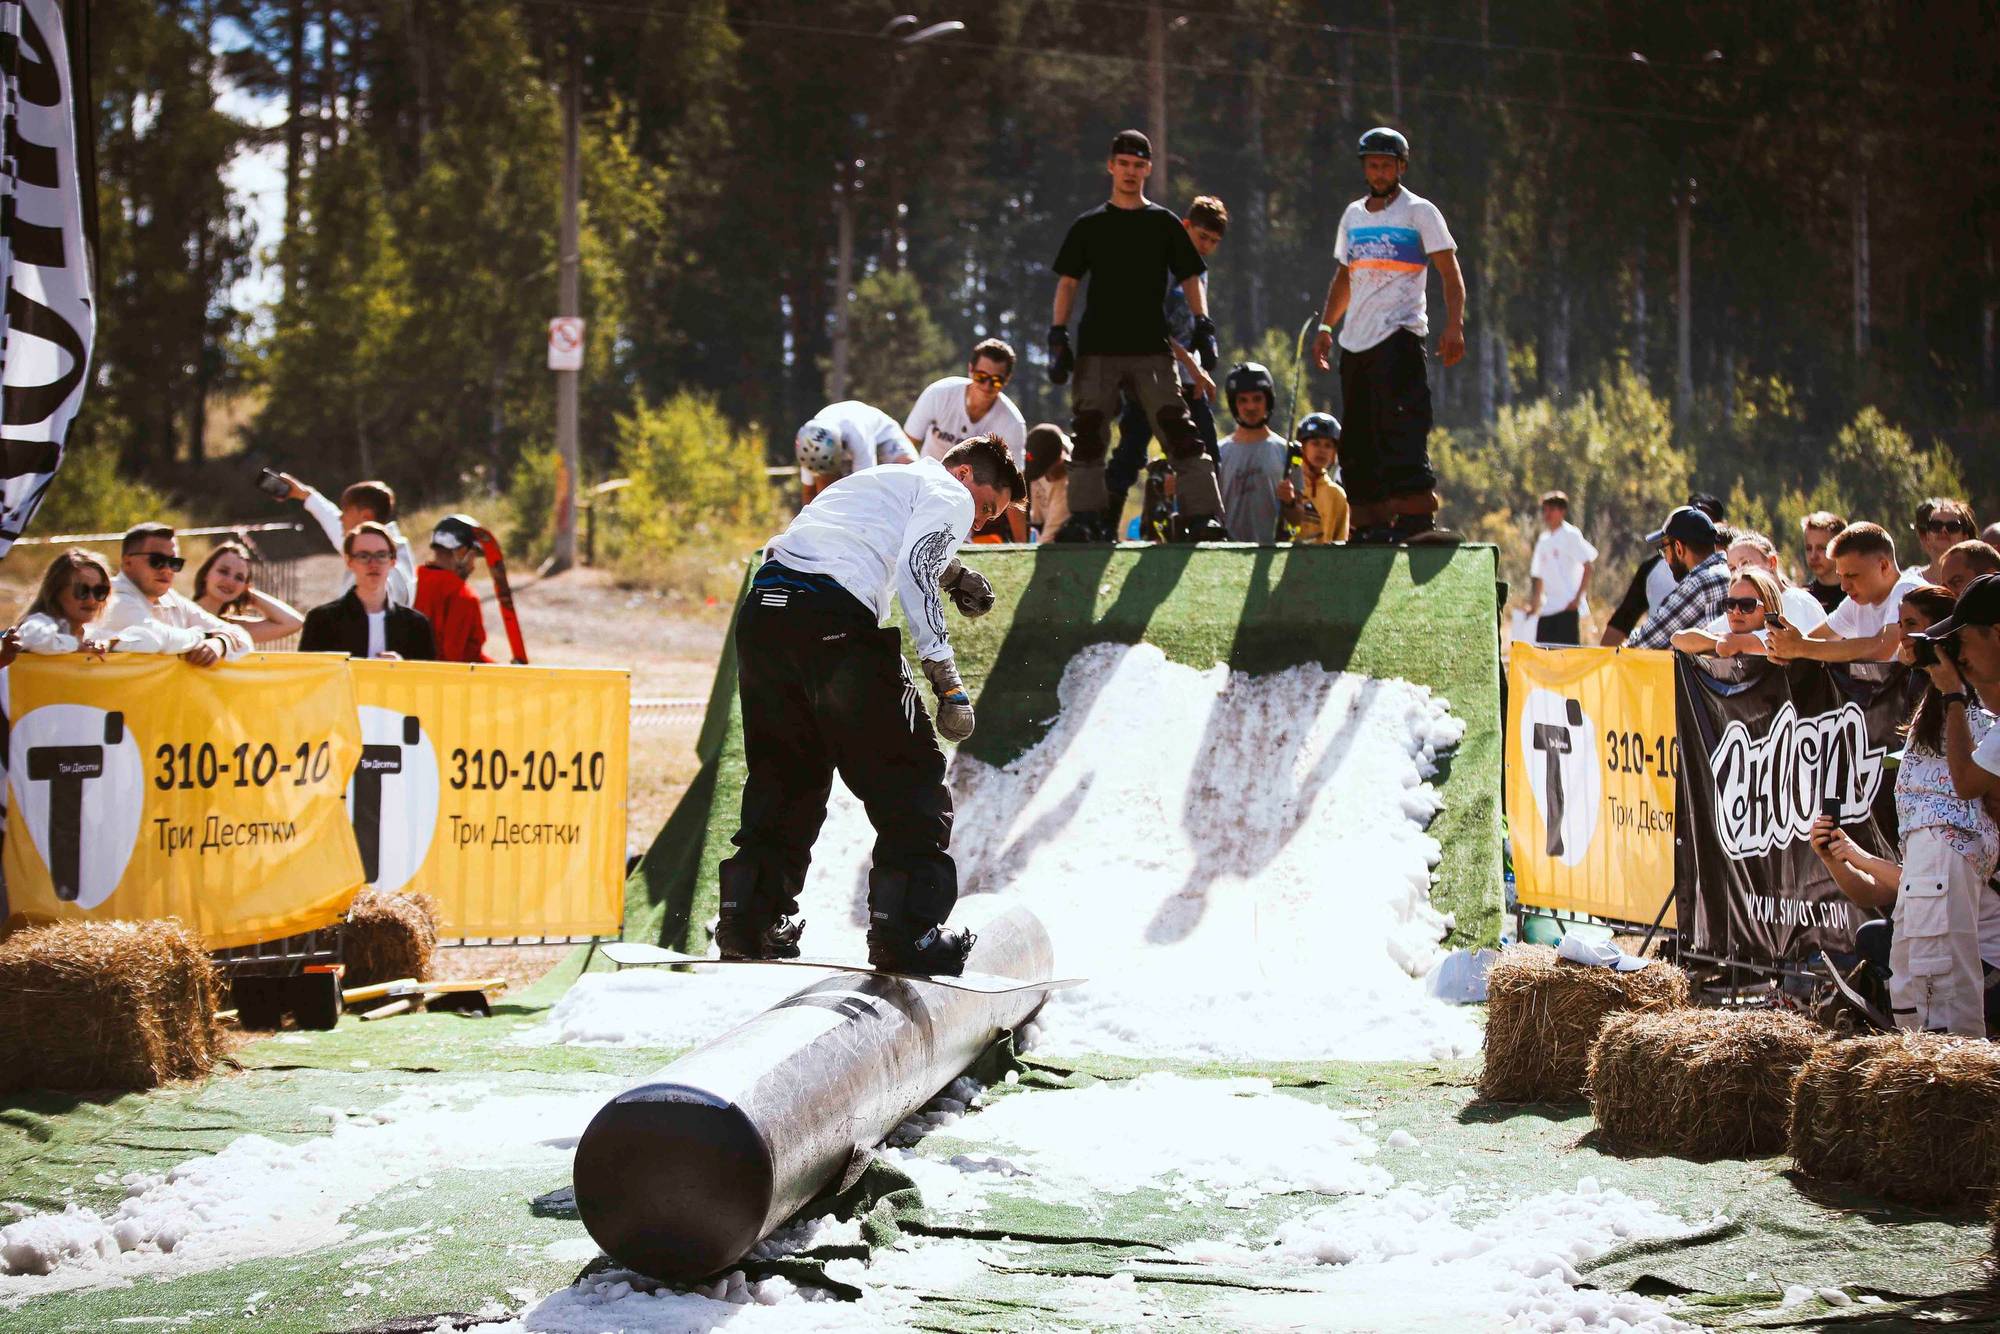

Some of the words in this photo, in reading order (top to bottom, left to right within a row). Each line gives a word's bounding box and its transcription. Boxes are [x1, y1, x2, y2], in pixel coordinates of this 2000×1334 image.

[154, 740, 331, 791] 310-10-10
[449, 747, 605, 792] 310-10-10
[449, 815, 485, 850] Три
[491, 815, 580, 850] Десятки
[1608, 796, 1634, 832] Три
[154, 816, 193, 856] Три
[200, 815, 297, 855] Десятки
